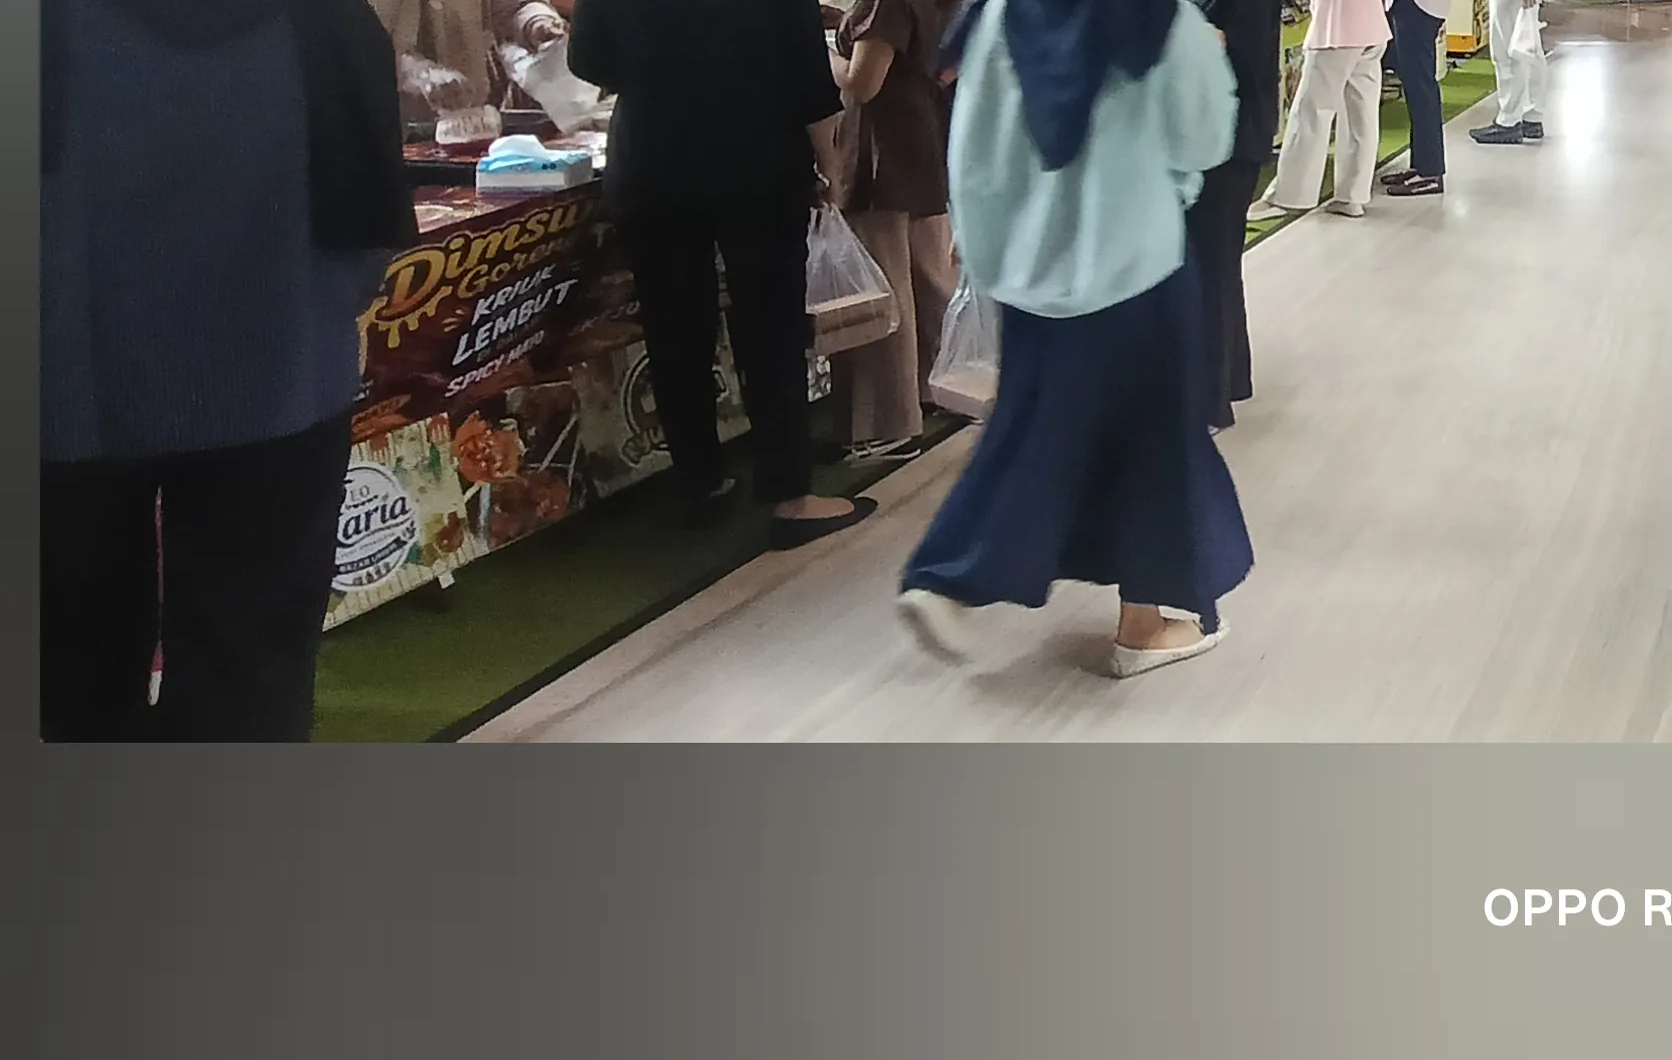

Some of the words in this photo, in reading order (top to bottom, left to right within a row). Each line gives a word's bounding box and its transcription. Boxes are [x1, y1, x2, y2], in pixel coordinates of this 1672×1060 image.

[378, 199, 597, 318] Dimsu
[451, 278, 579, 367] LEMBUT
[444, 353, 504, 398] SPICY
